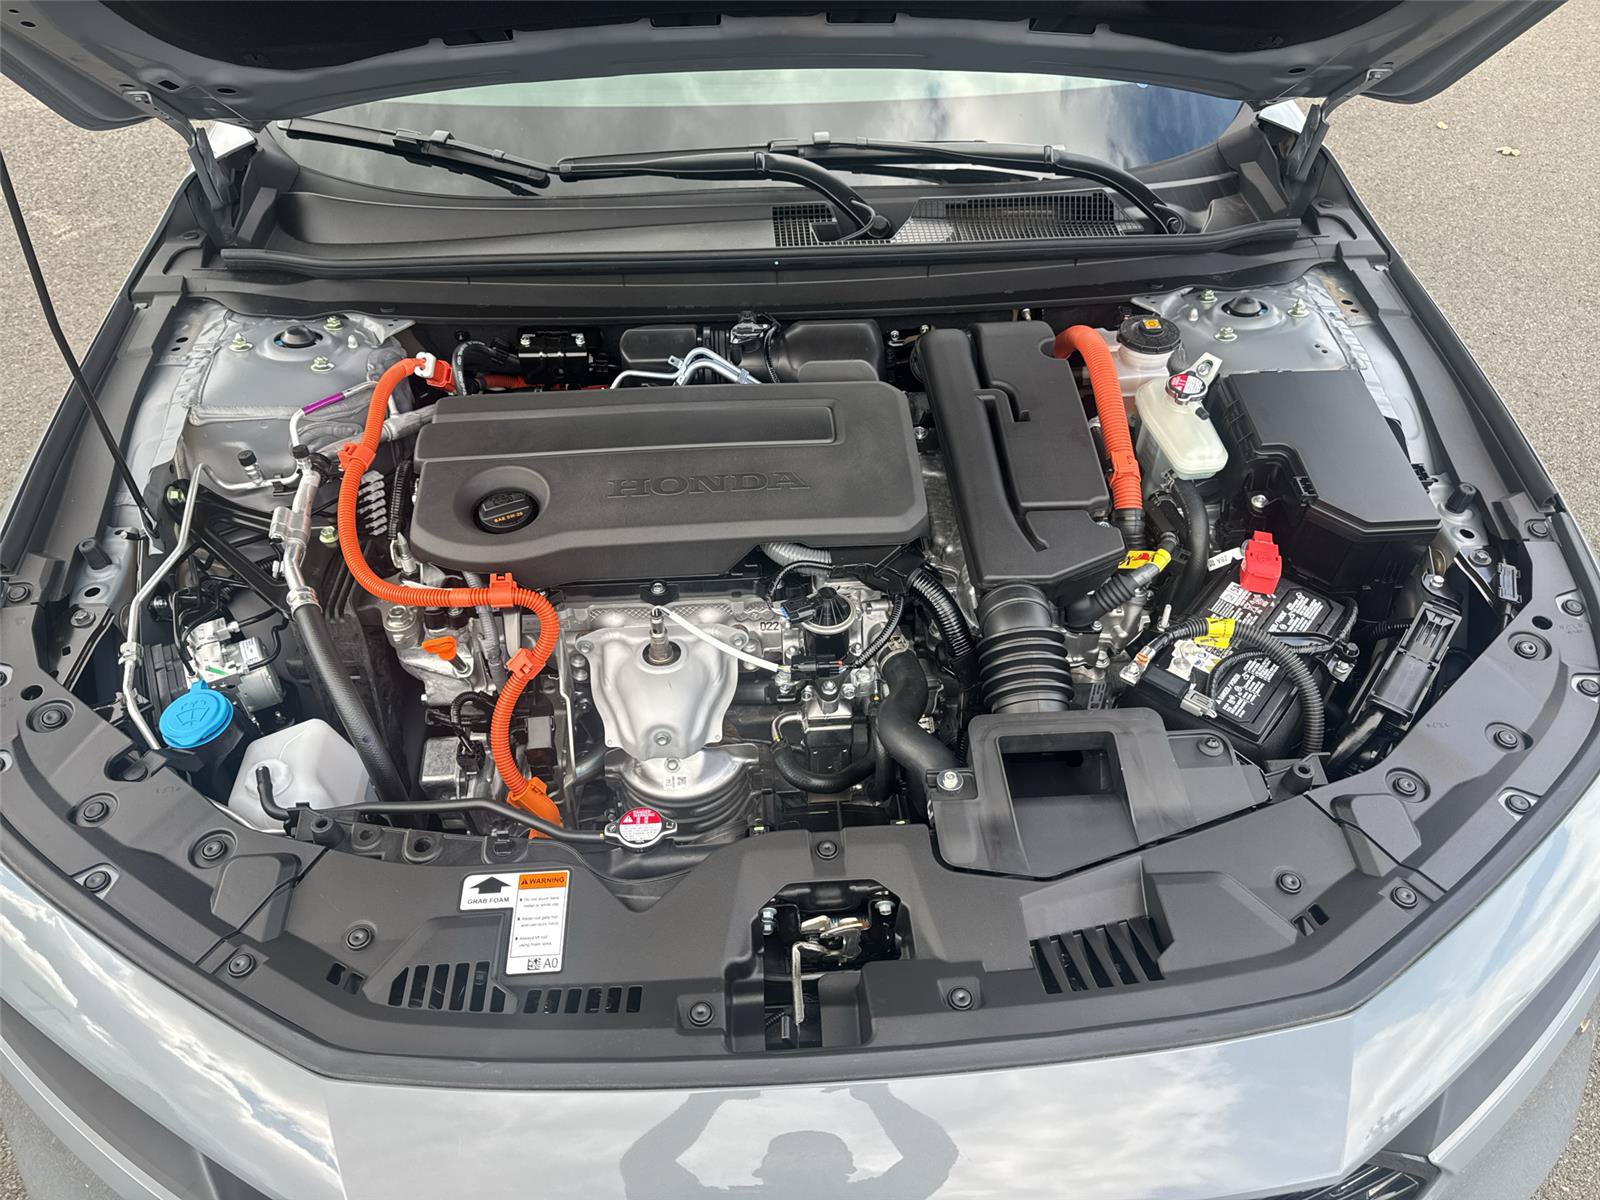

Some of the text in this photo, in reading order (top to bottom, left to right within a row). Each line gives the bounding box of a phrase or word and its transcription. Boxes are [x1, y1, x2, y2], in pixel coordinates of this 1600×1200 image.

[607, 471, 811, 499] HONDA
[760, 621, 779, 631] 022
[529, 876, 565, 885] WARNING
[467, 896, 510, 905] GRAB FOAM
[543, 957, 559, 969] A0
